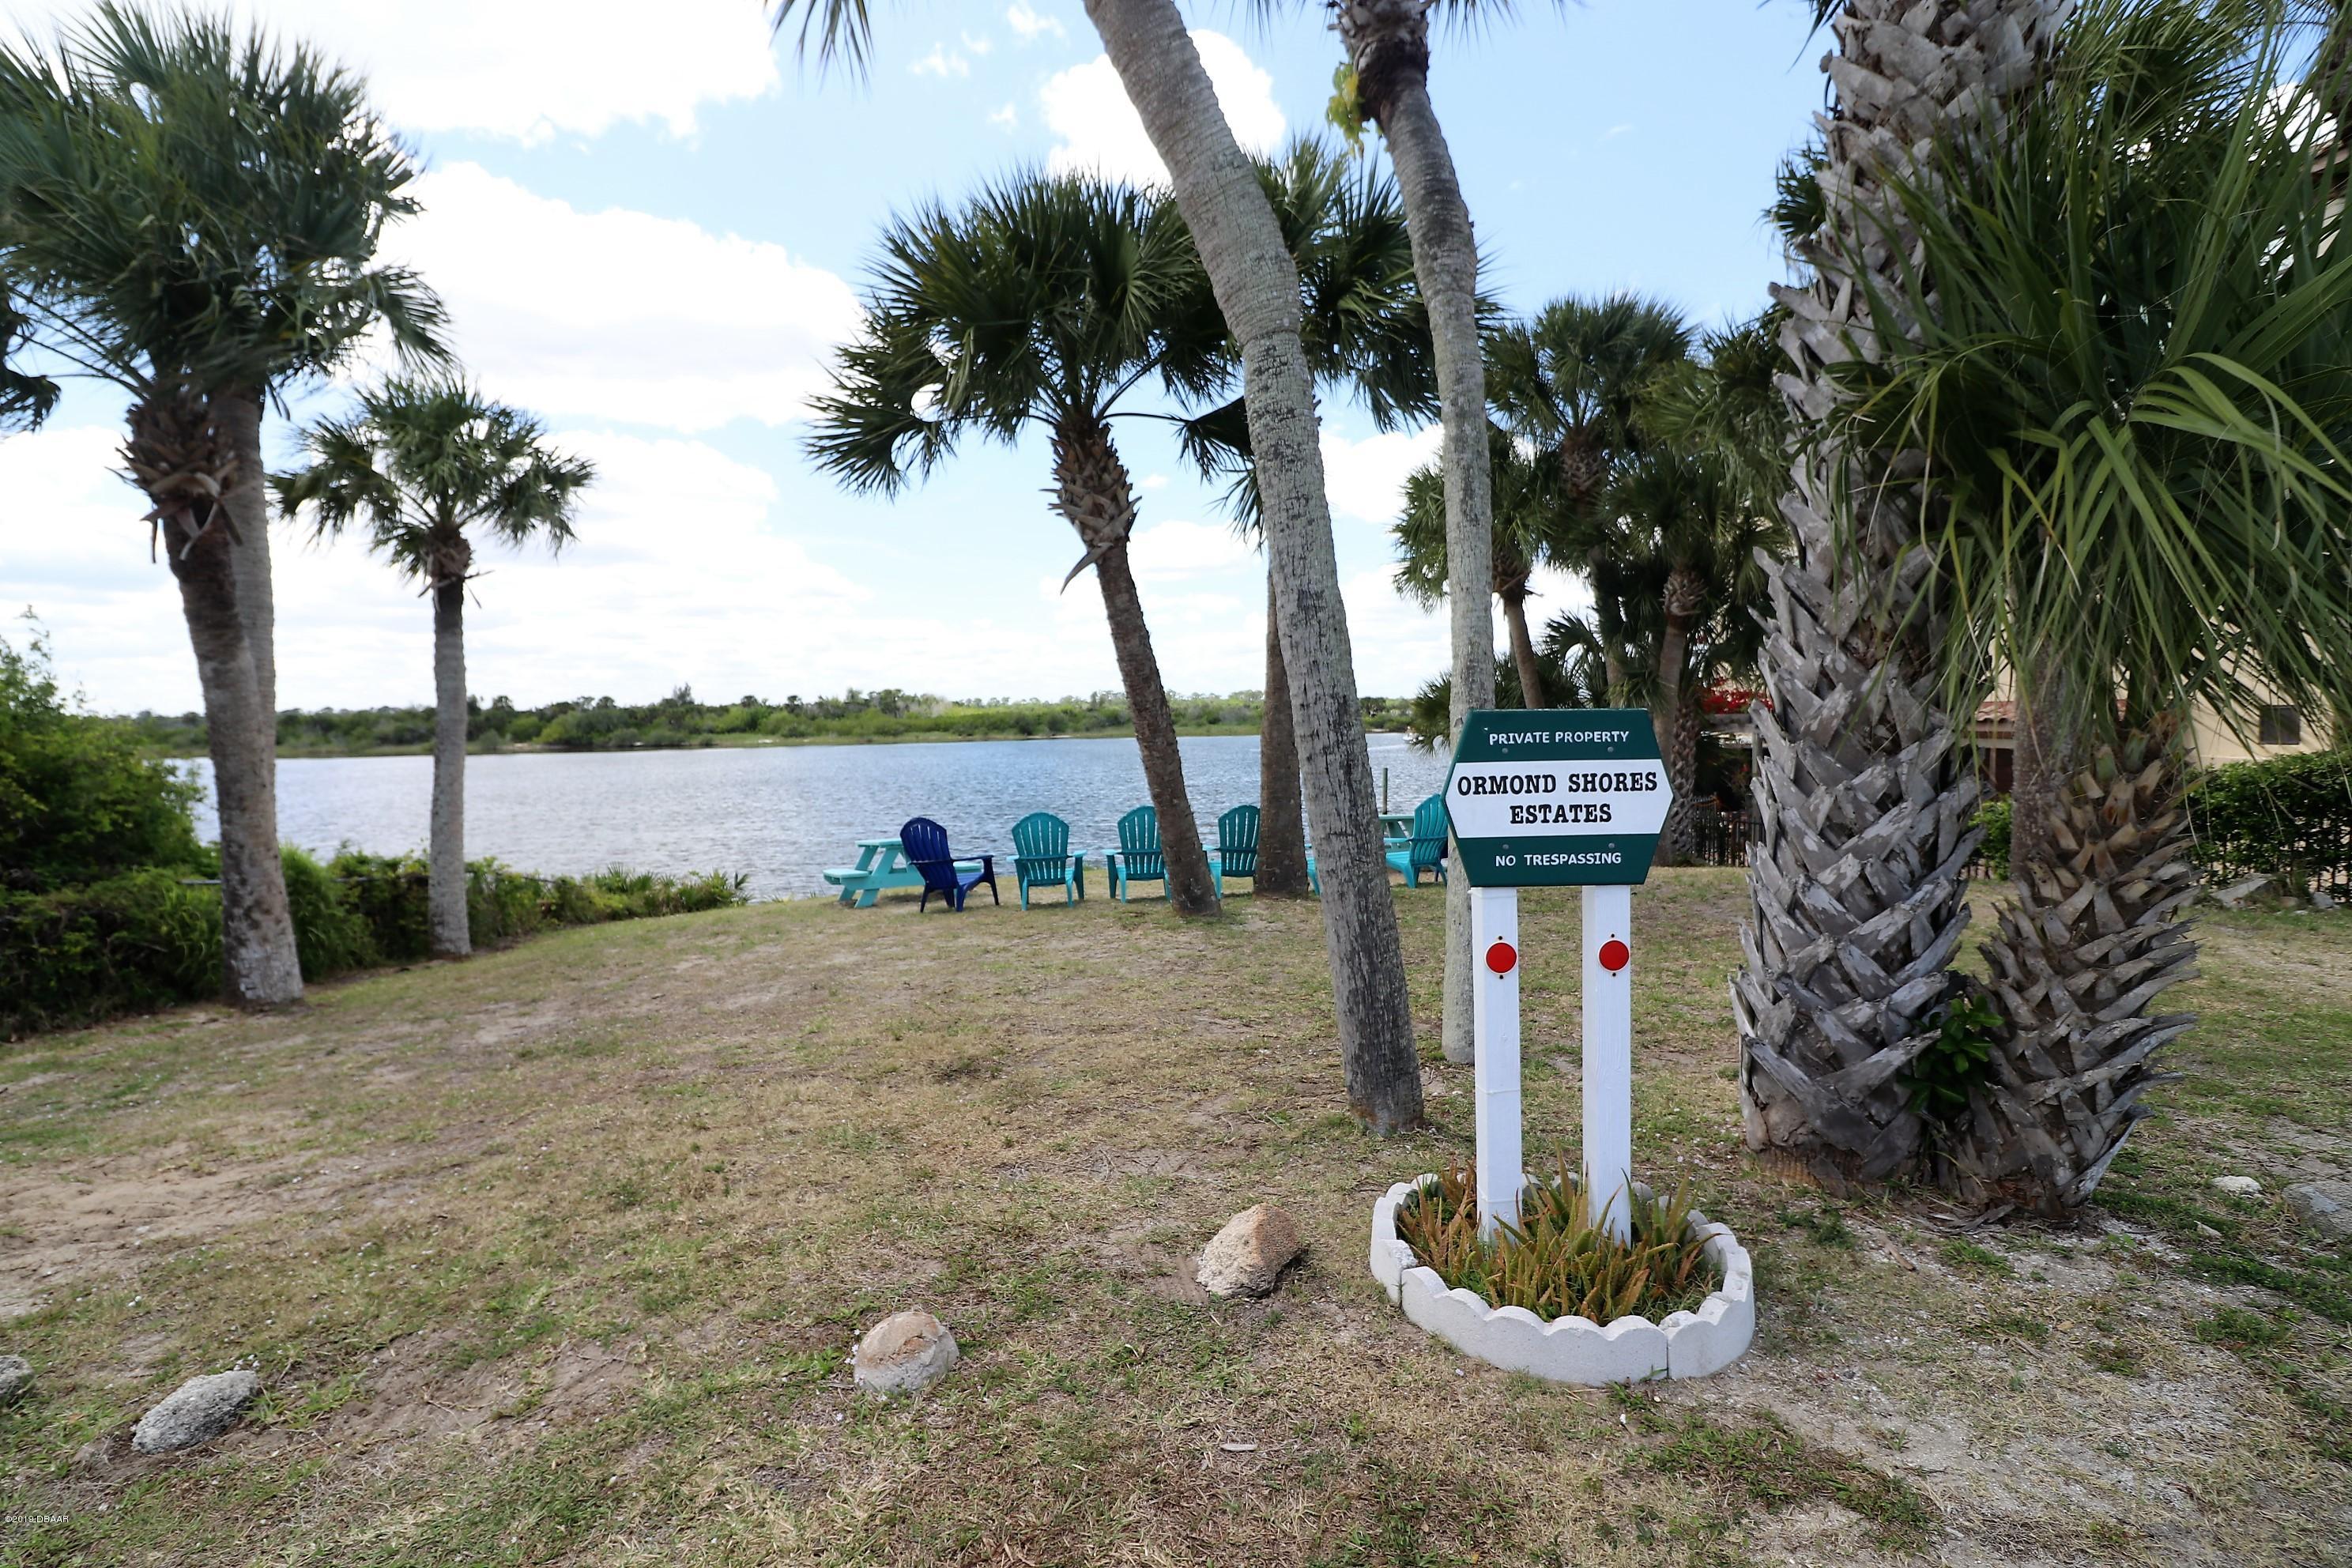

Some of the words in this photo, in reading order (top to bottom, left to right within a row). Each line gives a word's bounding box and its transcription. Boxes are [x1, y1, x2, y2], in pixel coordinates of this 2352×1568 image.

[1489, 731, 1550, 745] PRIVATE
[1555, 730, 1630, 743] PROPERTY
[1457, 774, 1556, 796] ORMOND
[1568, 771, 1657, 793] SHORES
[1510, 803, 1612, 824] ESTATES
[1495, 854, 1516, 867] NO
[1524, 852, 1622, 866] TRESPASSING
